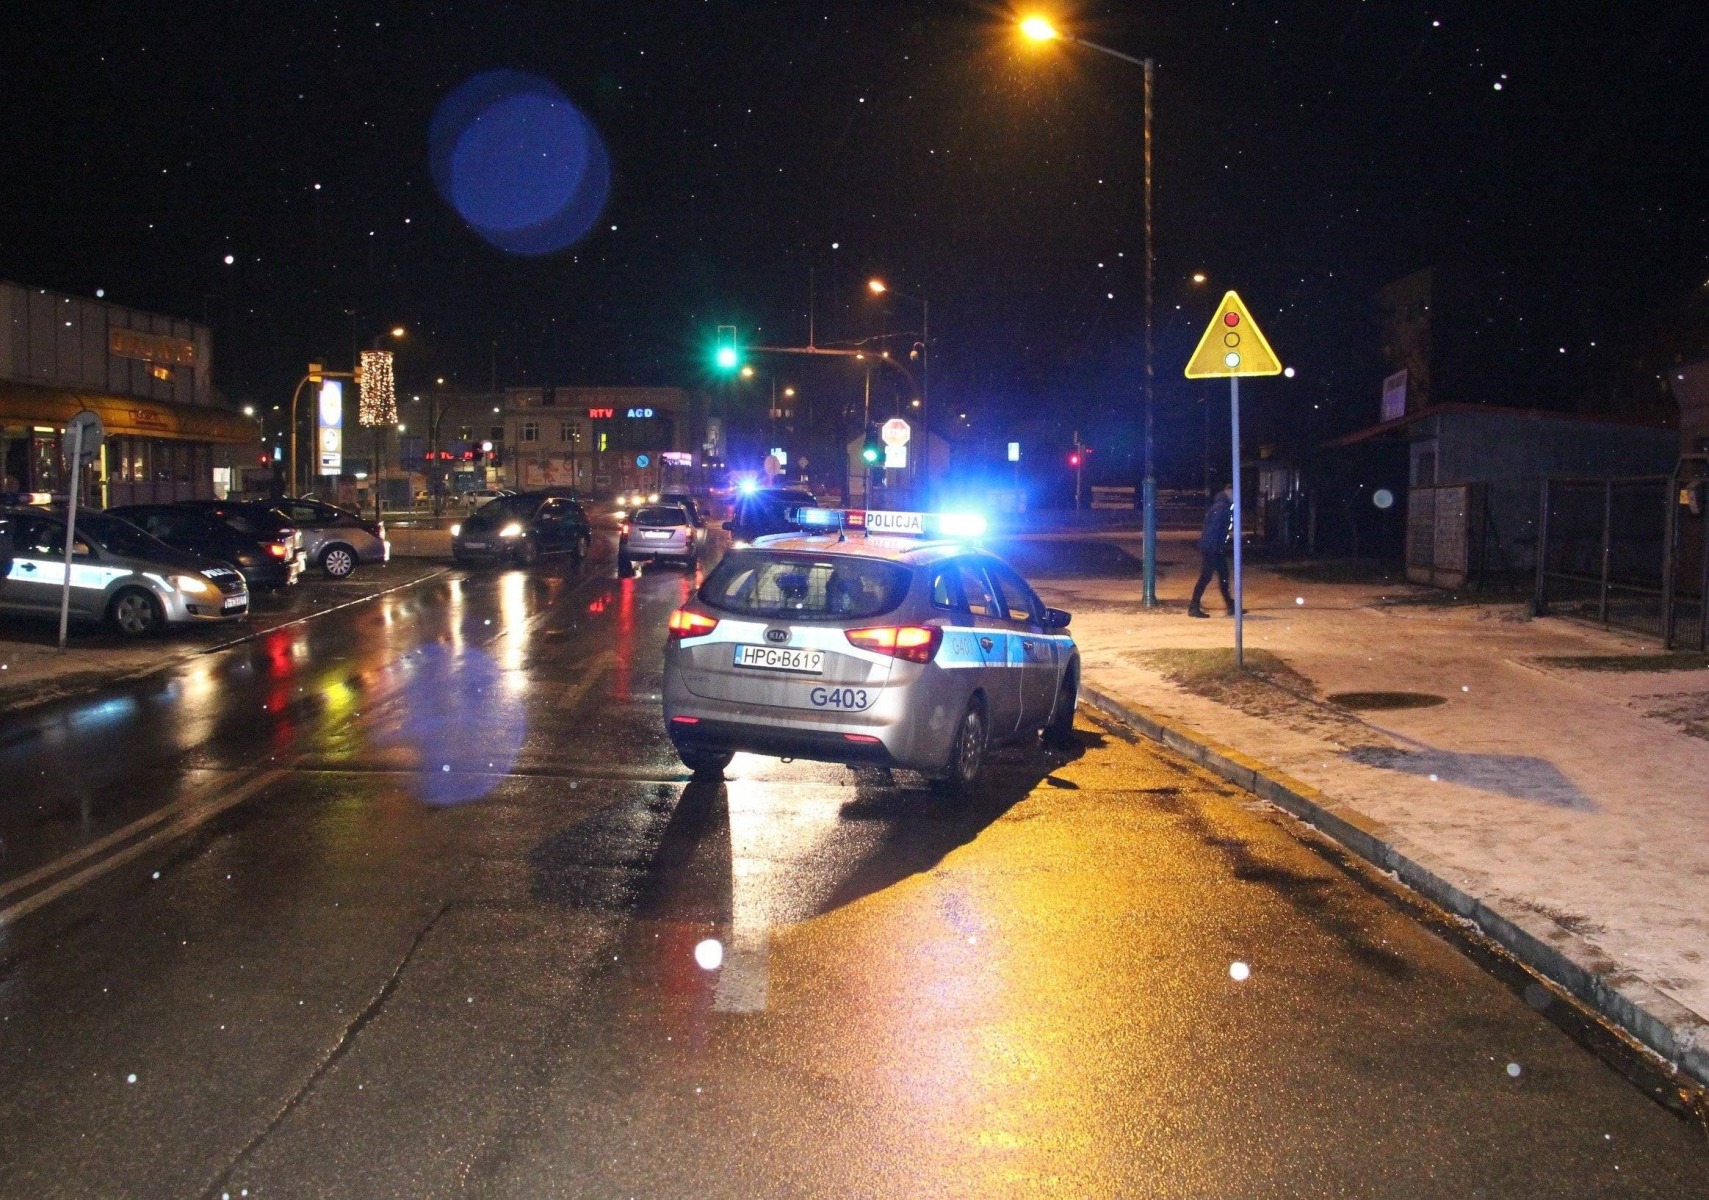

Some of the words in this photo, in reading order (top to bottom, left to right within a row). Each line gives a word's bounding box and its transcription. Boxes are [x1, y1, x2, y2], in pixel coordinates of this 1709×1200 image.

[589, 408, 613, 418] RTV
[866, 513, 920, 529] POLICJA
[769, 631, 785, 640] KIA
[743, 647, 777, 666] HPG
[781, 651, 821, 669] B619
[810, 688, 868, 709] G403
